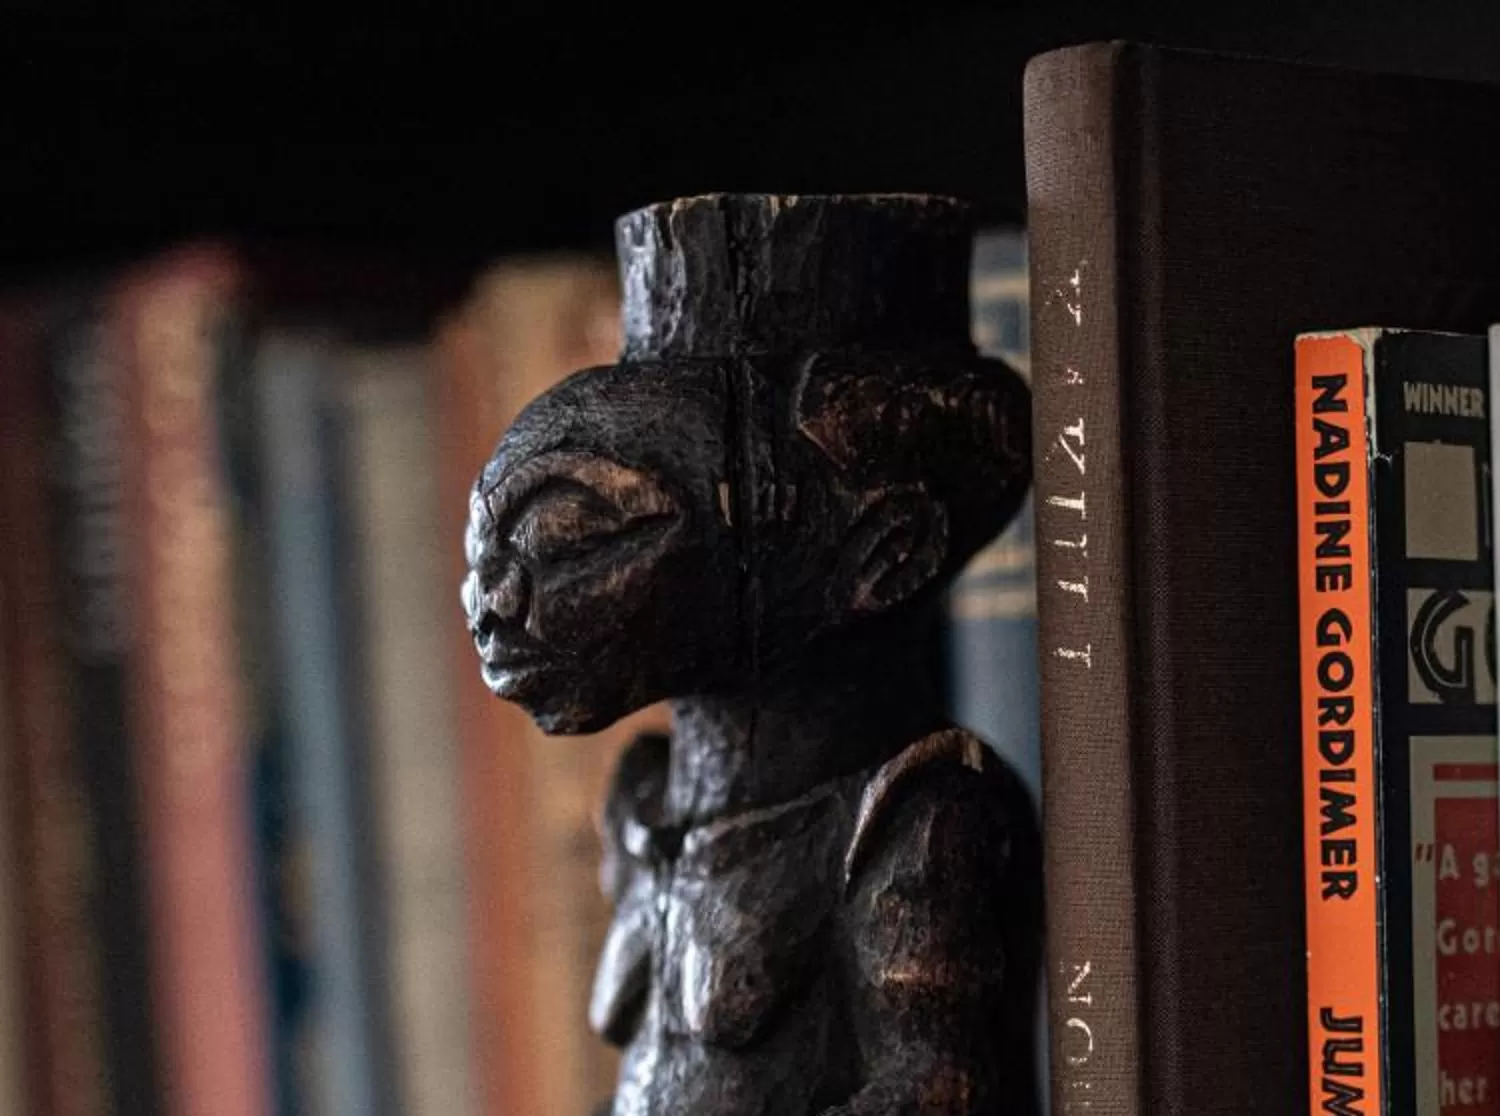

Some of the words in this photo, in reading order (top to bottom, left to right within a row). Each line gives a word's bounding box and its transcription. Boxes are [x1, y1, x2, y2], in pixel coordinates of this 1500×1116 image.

[1312, 373, 1352, 592] NADINE
[1403, 382, 1486, 419] WINNER
[1316, 607, 1358, 901] GORDIMER
